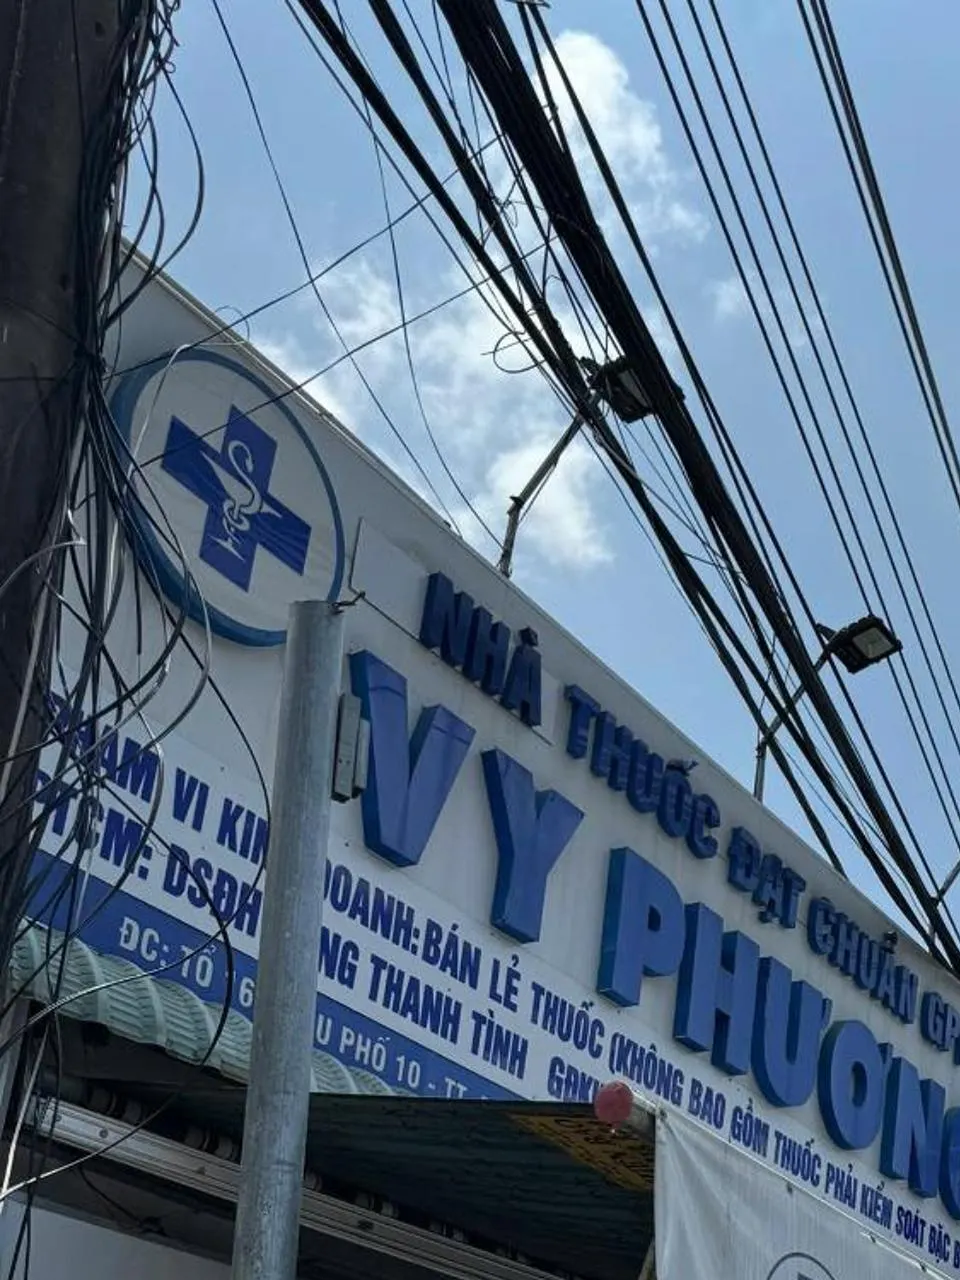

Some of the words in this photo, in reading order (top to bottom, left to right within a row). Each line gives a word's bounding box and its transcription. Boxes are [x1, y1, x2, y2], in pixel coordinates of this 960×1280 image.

[350, 649, 585, 944] VY
[420, 571, 541, 727] NHÀ
[564, 684, 721, 860] THUỐC
[727, 825, 806, 929] ĐẠT
[806, 896, 920, 1024] CHUẨN
[172, 767, 210, 833] VI
[216, 798, 269, 866] KIN
[489, 954, 521, 1013] LẺ
[530, 981, 605, 1059] THUỐC
[608, 1031, 685, 1107] (KHÔNG
[688, 1078, 726, 1130] BAO
[730, 1098, 770, 1158] GỒM
[774, 1130, 822, 1187] THUỐC
[824, 1162, 857, 1211] PHẢI
[895, 1205, 927, 1248] SOÁT
[318, 926, 360, 989] NG
[368, 953, 463, 1045] THANH
[470, 1008, 528, 1080] TÌNH
[340, 1025, 391, 1072] PHỐ
[396, 1055, 421, 1088] 10
